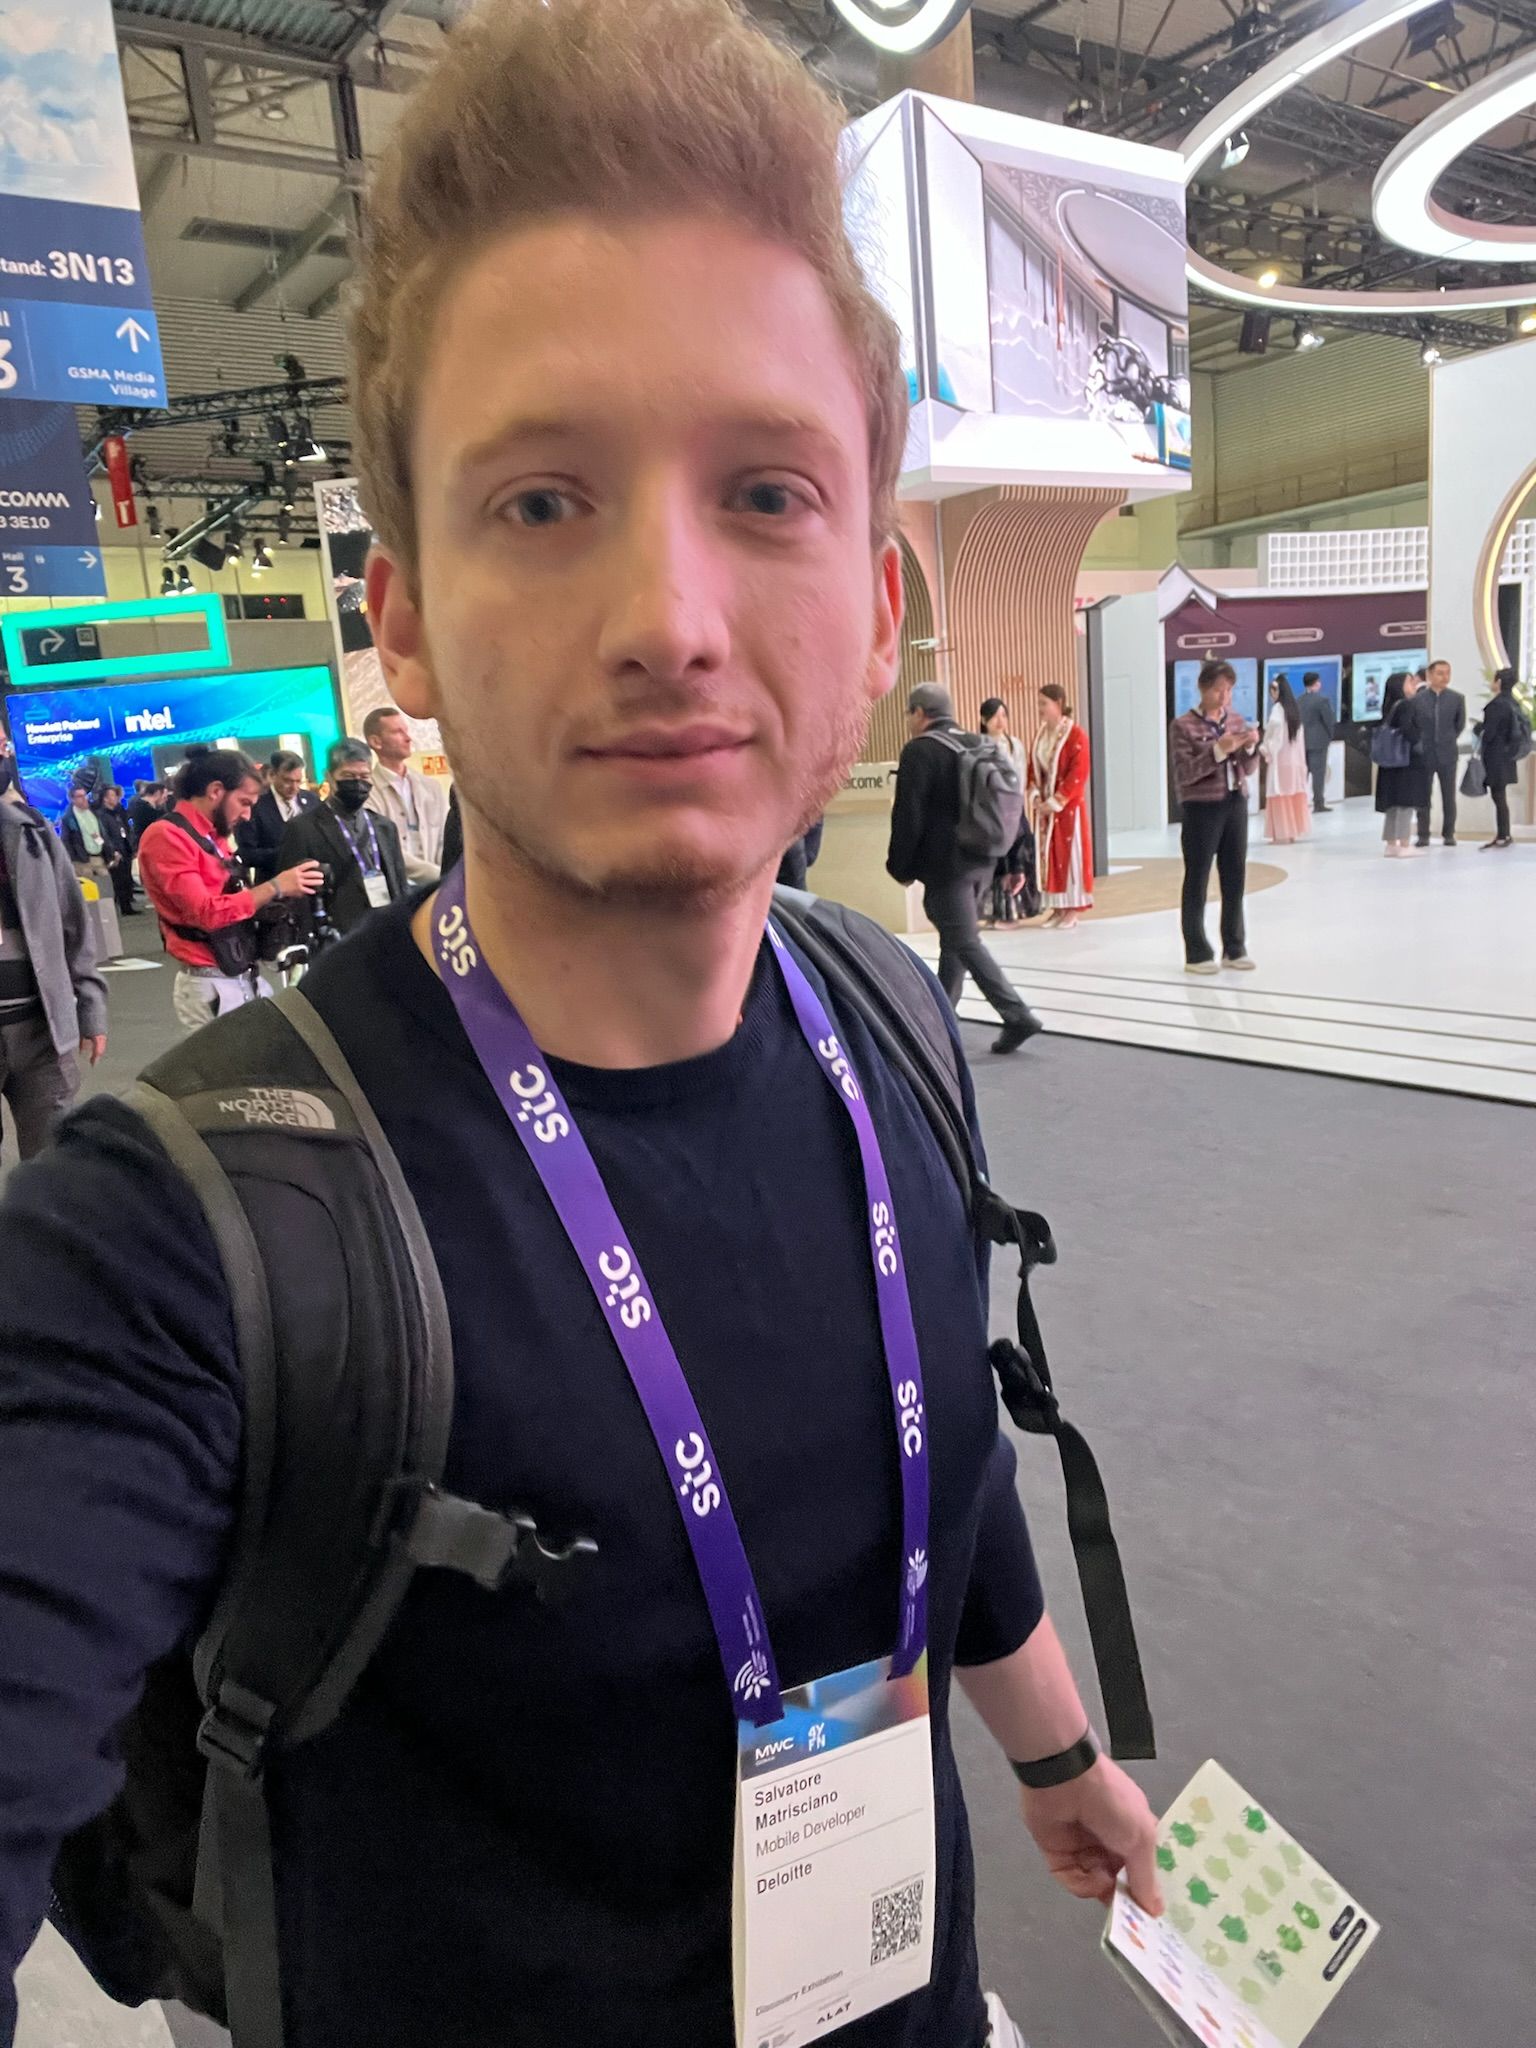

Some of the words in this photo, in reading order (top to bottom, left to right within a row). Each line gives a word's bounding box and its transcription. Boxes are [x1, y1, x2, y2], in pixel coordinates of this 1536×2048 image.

[0, 258, 47, 276] tand:
[48, 250, 135, 286] 3N13
[68, 366, 111, 382] GSMA
[114, 370, 155, 383] Media
[109, 384, 157, 399] Village
[9, 515, 50, 529] 3E10
[6, 566, 29, 593] 3
[438, 905, 477, 977] stc
[219, 1099, 294, 1112] NORTH
[248, 1088, 292, 1101] THE
[509, 1064, 569, 1144] stc
[245, 1112, 298, 1126] FACE
[872, 1201, 898, 1277] stc
[598, 1245, 651, 1328] stc
[897, 1379, 923, 1458] stc
[675, 1432, 720, 1517] stc
[755, 1736, 795, 1760] MWC
[754, 1772, 822, 1806] Salvatore
[755, 1789, 838, 1831] Matrisciano
[755, 1831, 800, 1857] Mobile
[803, 1804, 866, 1834] Developer
[757, 1862, 813, 1895] Deloitte
[816, 2001, 852, 2025] ALAT
